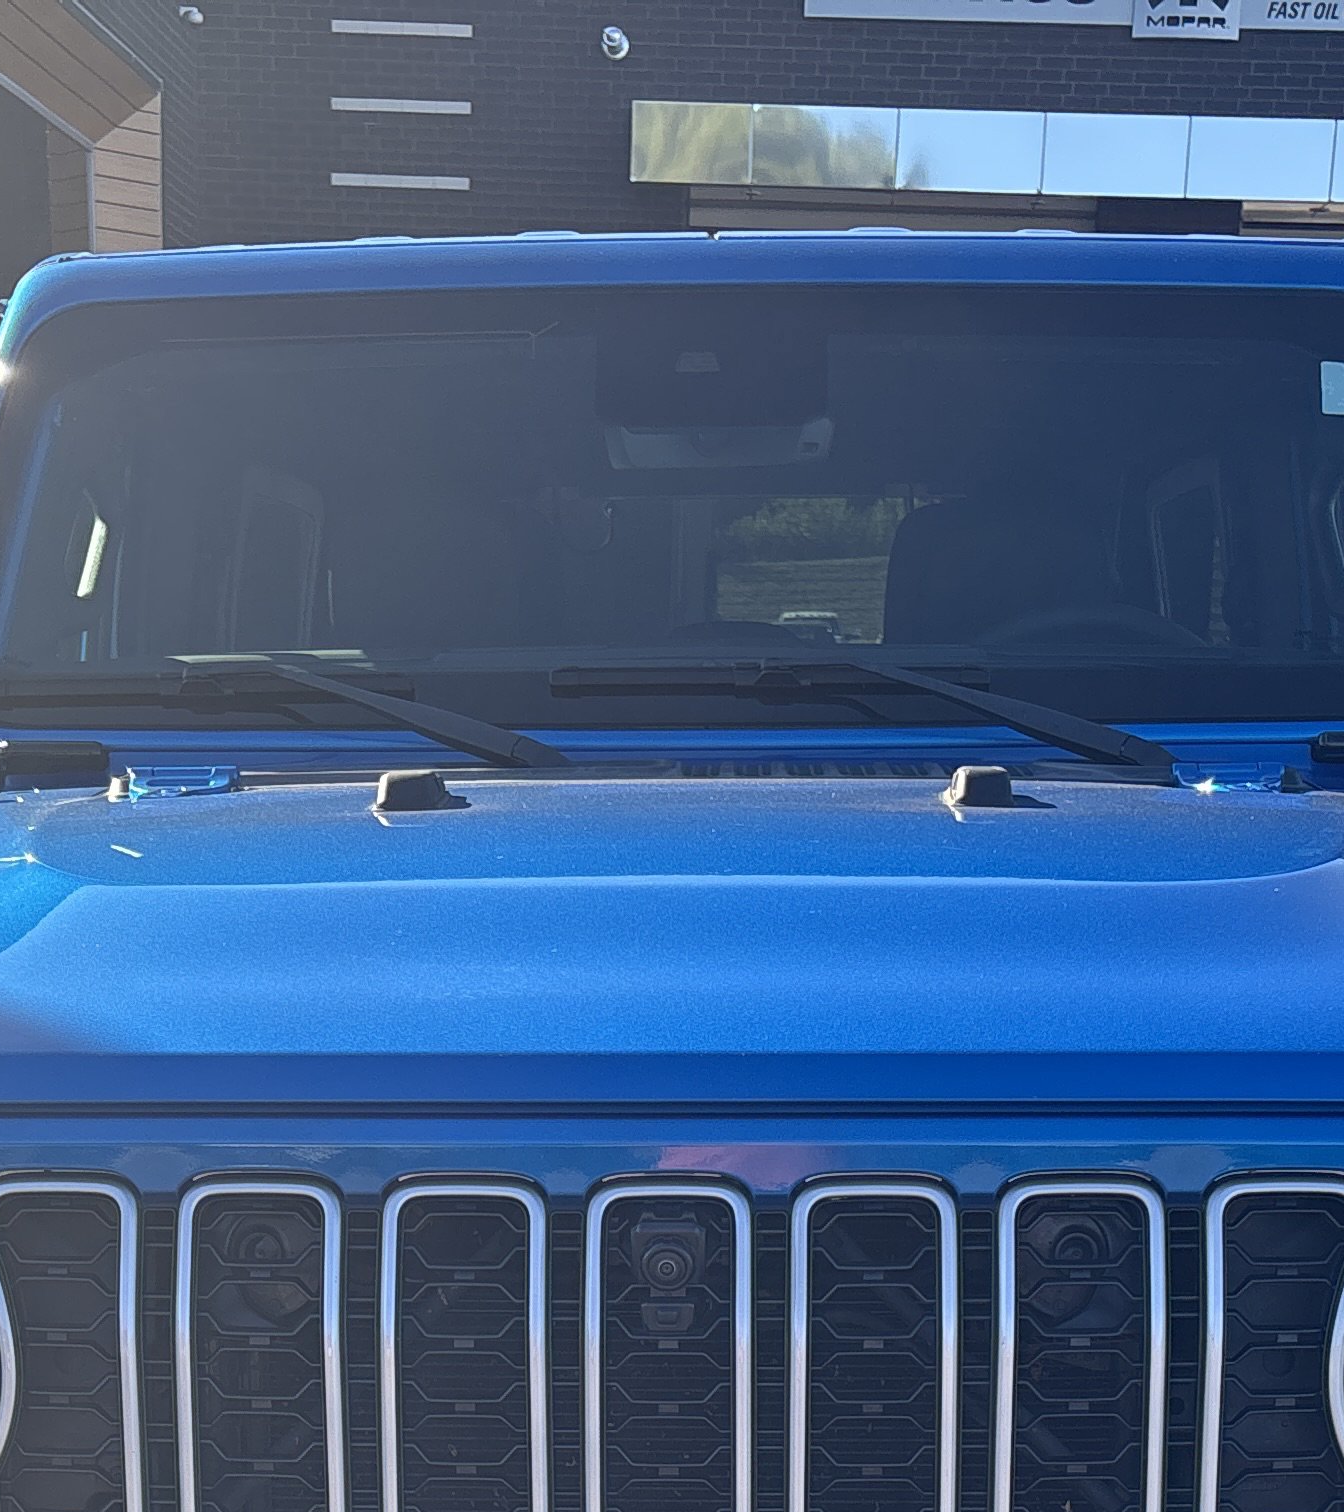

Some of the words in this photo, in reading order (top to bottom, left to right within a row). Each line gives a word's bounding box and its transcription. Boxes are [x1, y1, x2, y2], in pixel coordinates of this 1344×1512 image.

[1266, 1, 1311, 19] FAST
[1312, 2, 1338, 20] OIL
[1146, 15, 1226, 29] MOPAR
